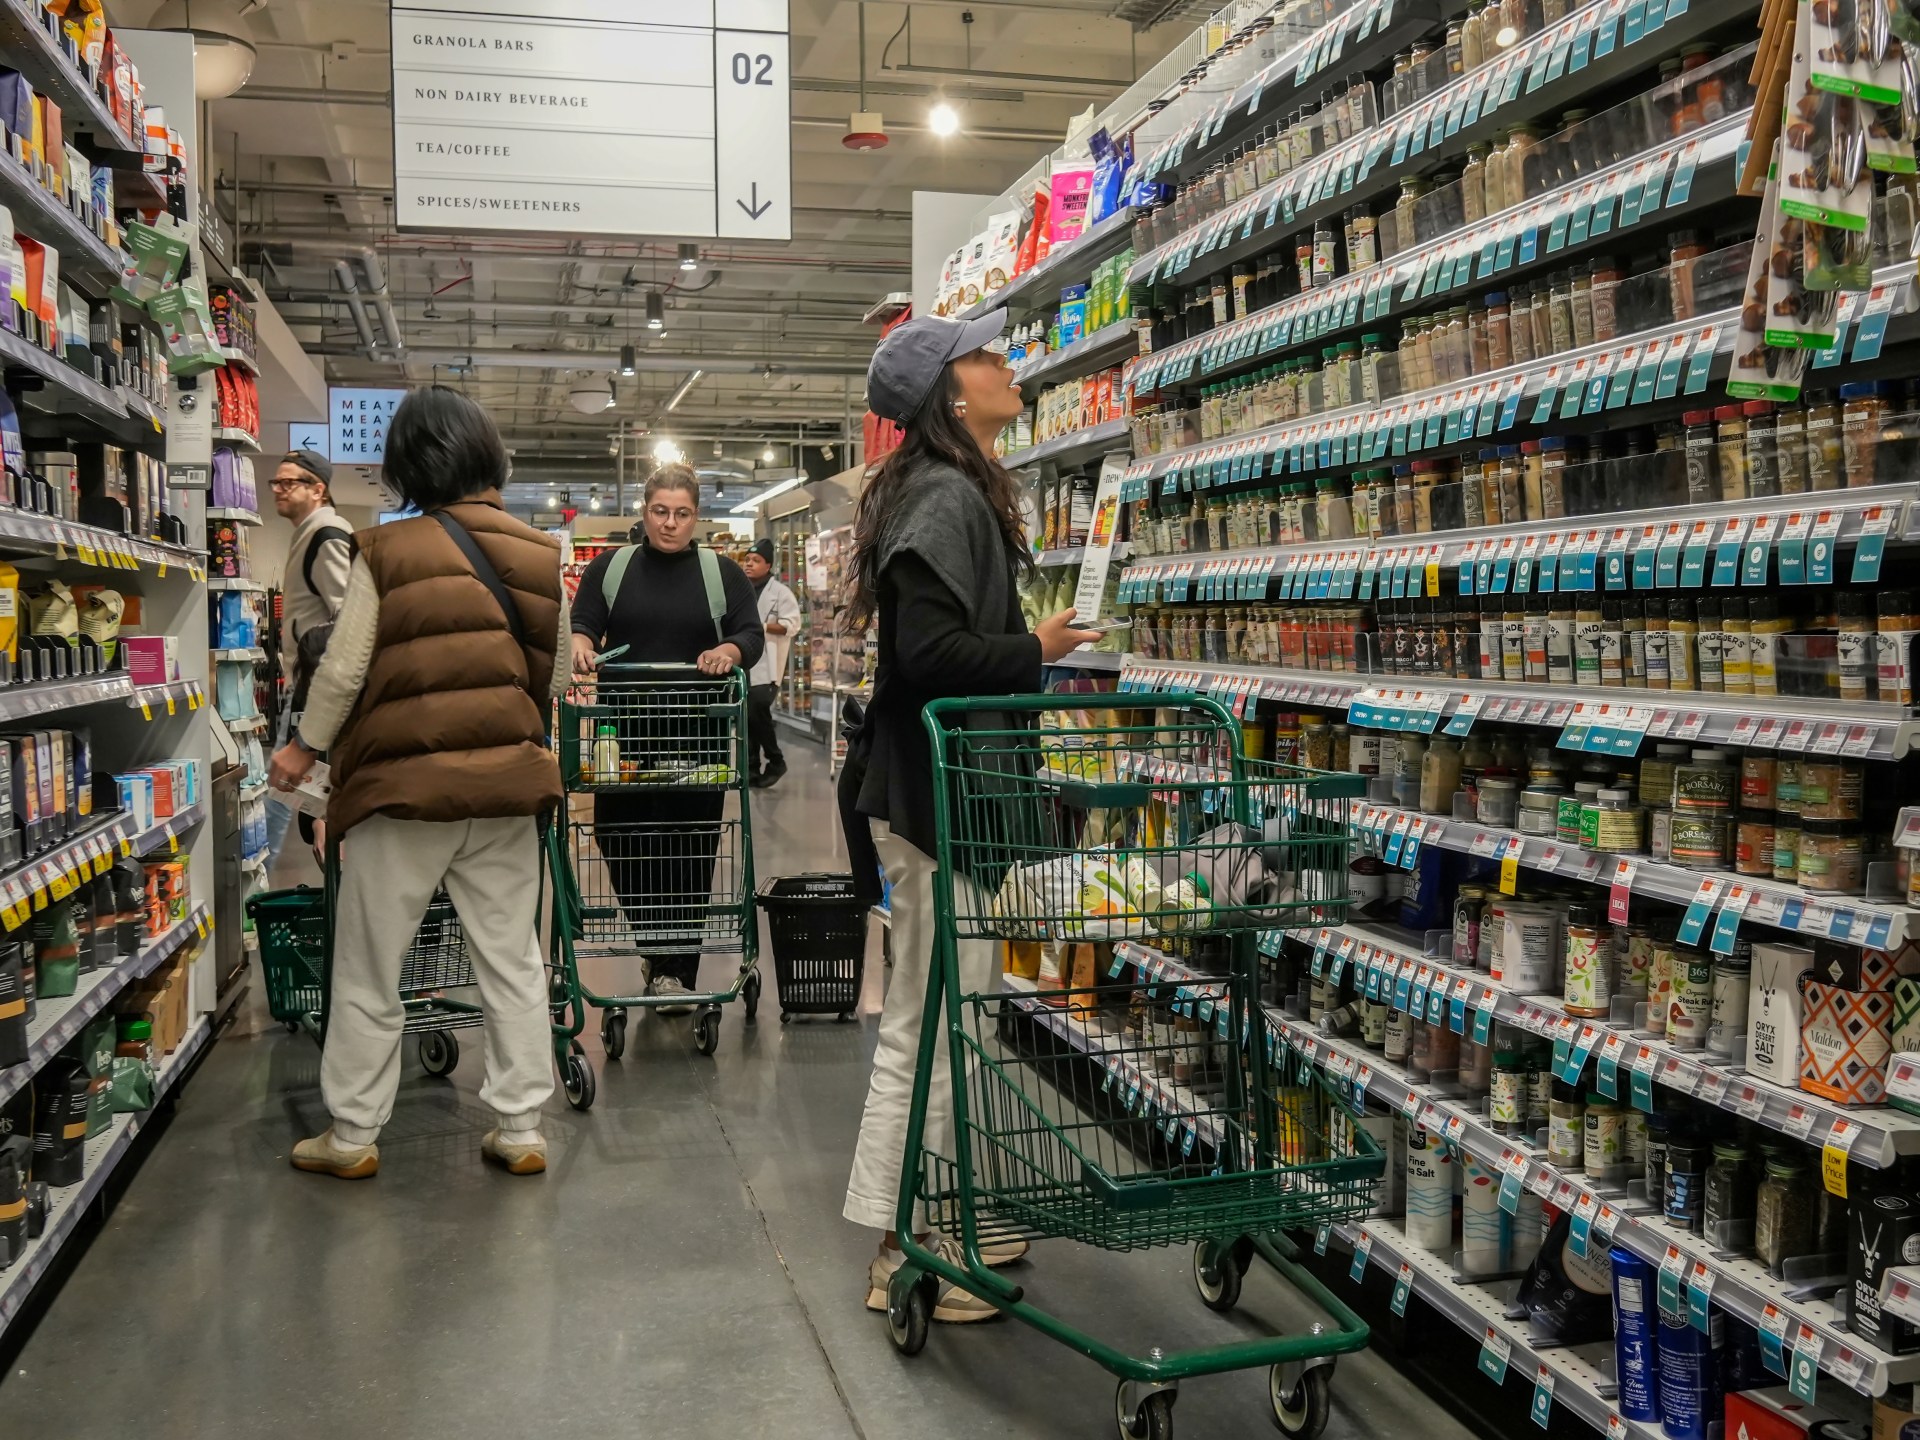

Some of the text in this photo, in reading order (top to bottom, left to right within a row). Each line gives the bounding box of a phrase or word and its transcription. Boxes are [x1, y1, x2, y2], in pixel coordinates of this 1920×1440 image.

[413, 34, 534, 52] GRANOLA BARS
[732, 52, 773, 86] 02
[415, 88, 589, 108] NON DAIRY BEVERAGE
[416, 142, 511, 157] TEA/COFFEE
[417, 196, 581, 212] SPICES/SWEETENERS
[1063, 195, 1089, 203] MONKFRU
[1062, 203, 1088, 211] SWEETEN
[1860, 333, 1879, 341] Kosher
[342, 400, 395, 411] MEAT
[342, 429, 382, 439] MEA
[342, 443, 382, 453] MEA
[1105, 474, 1119, 484] new
[1684, 782, 1724, 793] BORSARI
[1612, 900, 1625, 911] LOCAL
[1687, 919, 1700, 927] Kosher
[1719, 927, 1733, 935] Kosher
[1690, 967, 1708, 977] 365
[1678, 996, 1700, 1005] Steak
[1756, 1021, 1776, 1035] ORYX
[1755, 1031, 1775, 1044] DESERT
[1810, 1029, 1842, 1050] Maldon
[1755, 1040, 1775, 1056] SALT
[1586, 1137, 1599, 1145] White
[1409, 1155, 1426, 1167] Fine
[1827, 1153, 1841, 1165] Low
[1416, 1167, 1435, 1178] Salt
[1826, 1166, 1844, 1180] Price
[1856, 1280, 1880, 1299] ORYX
[1855, 1291, 1881, 1310] BLACK
[1856, 1300, 1881, 1321] PEPPER
[1626, 1379, 1644, 1389] Fine
